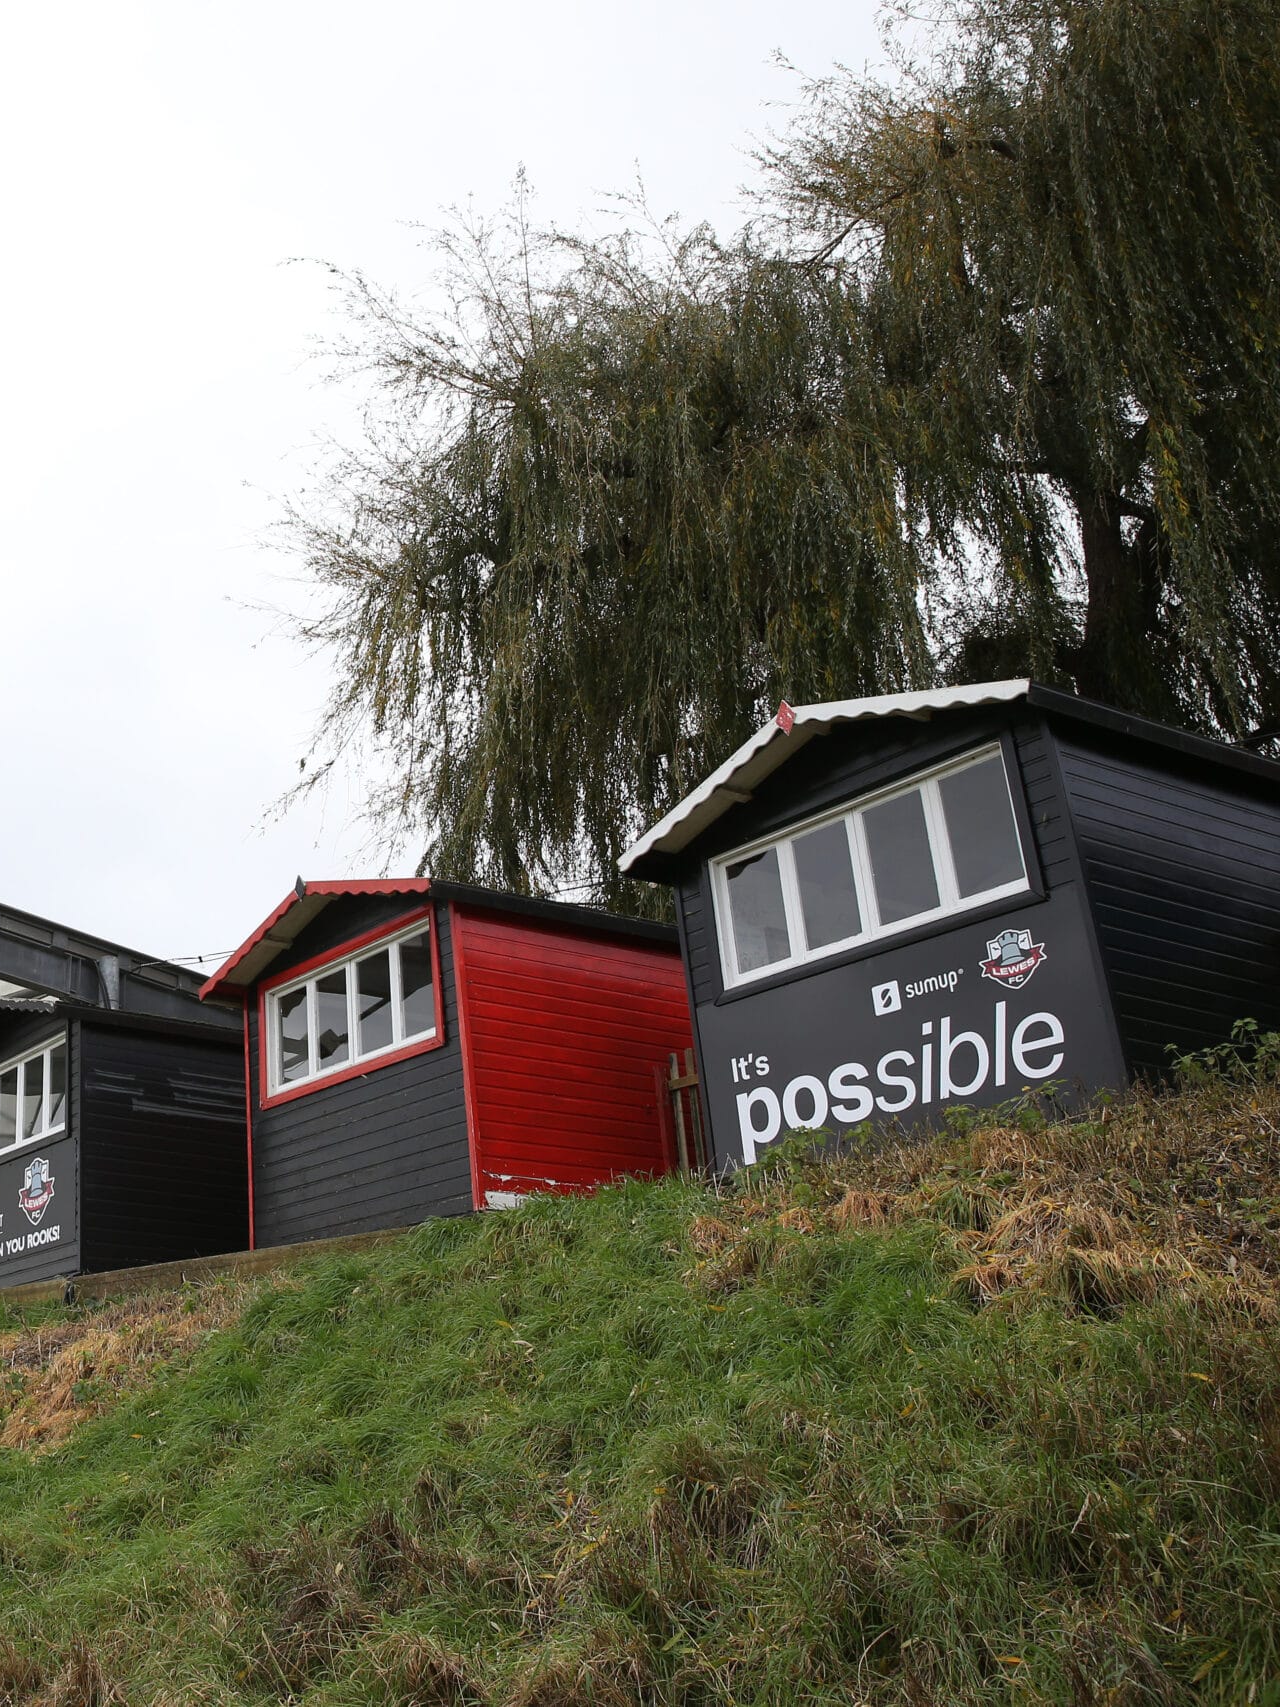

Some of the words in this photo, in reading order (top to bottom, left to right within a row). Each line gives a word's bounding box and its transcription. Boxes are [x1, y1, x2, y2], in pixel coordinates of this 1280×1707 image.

[991, 957, 1035, 977] LEWES
[1008, 974, 1024, 985] FC
[731, 1053, 770, 1083] It's
[735, 1001, 1065, 1166] possible
[31, 1210, 41, 1219] FC
[6, 1236, 25, 1255] YOU
[27, 1225, 60, 1249] ROOKS!
